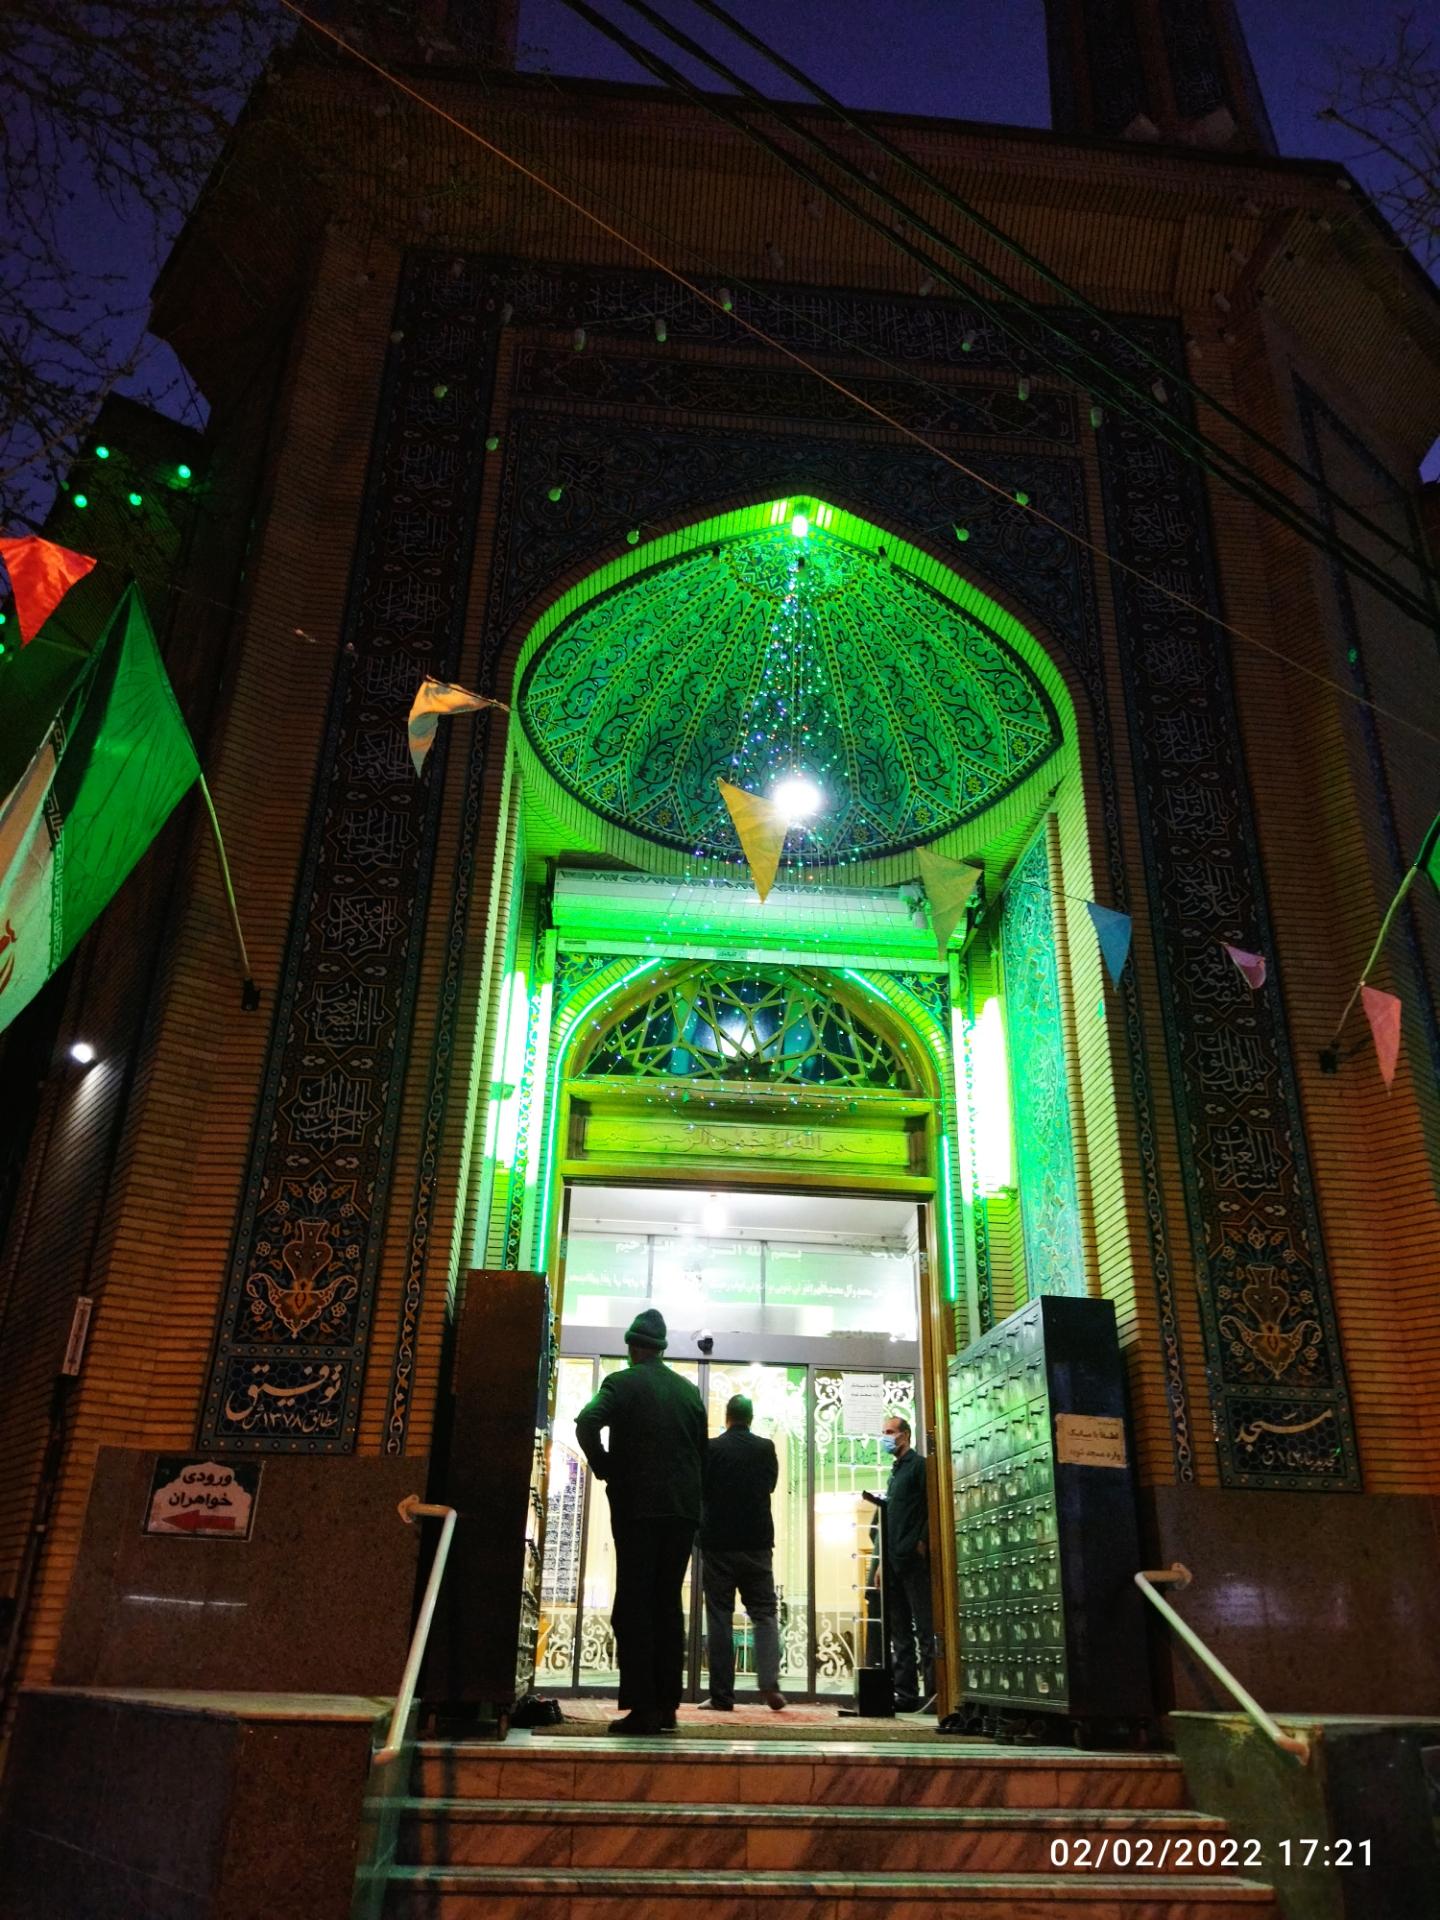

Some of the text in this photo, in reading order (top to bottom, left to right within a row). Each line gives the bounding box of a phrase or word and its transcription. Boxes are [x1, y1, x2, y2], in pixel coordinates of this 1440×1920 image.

[225, 1363, 344, 1421] توفیق
[263, 1412, 302, 1428] ۱۳۷۸
[302, 1409, 338, 1433] مطابق
[1234, 1407, 1333, 1453] مسجد
[182, 1470, 233, 1487] ورودی
[169, 1491, 233, 1510] خواهران
